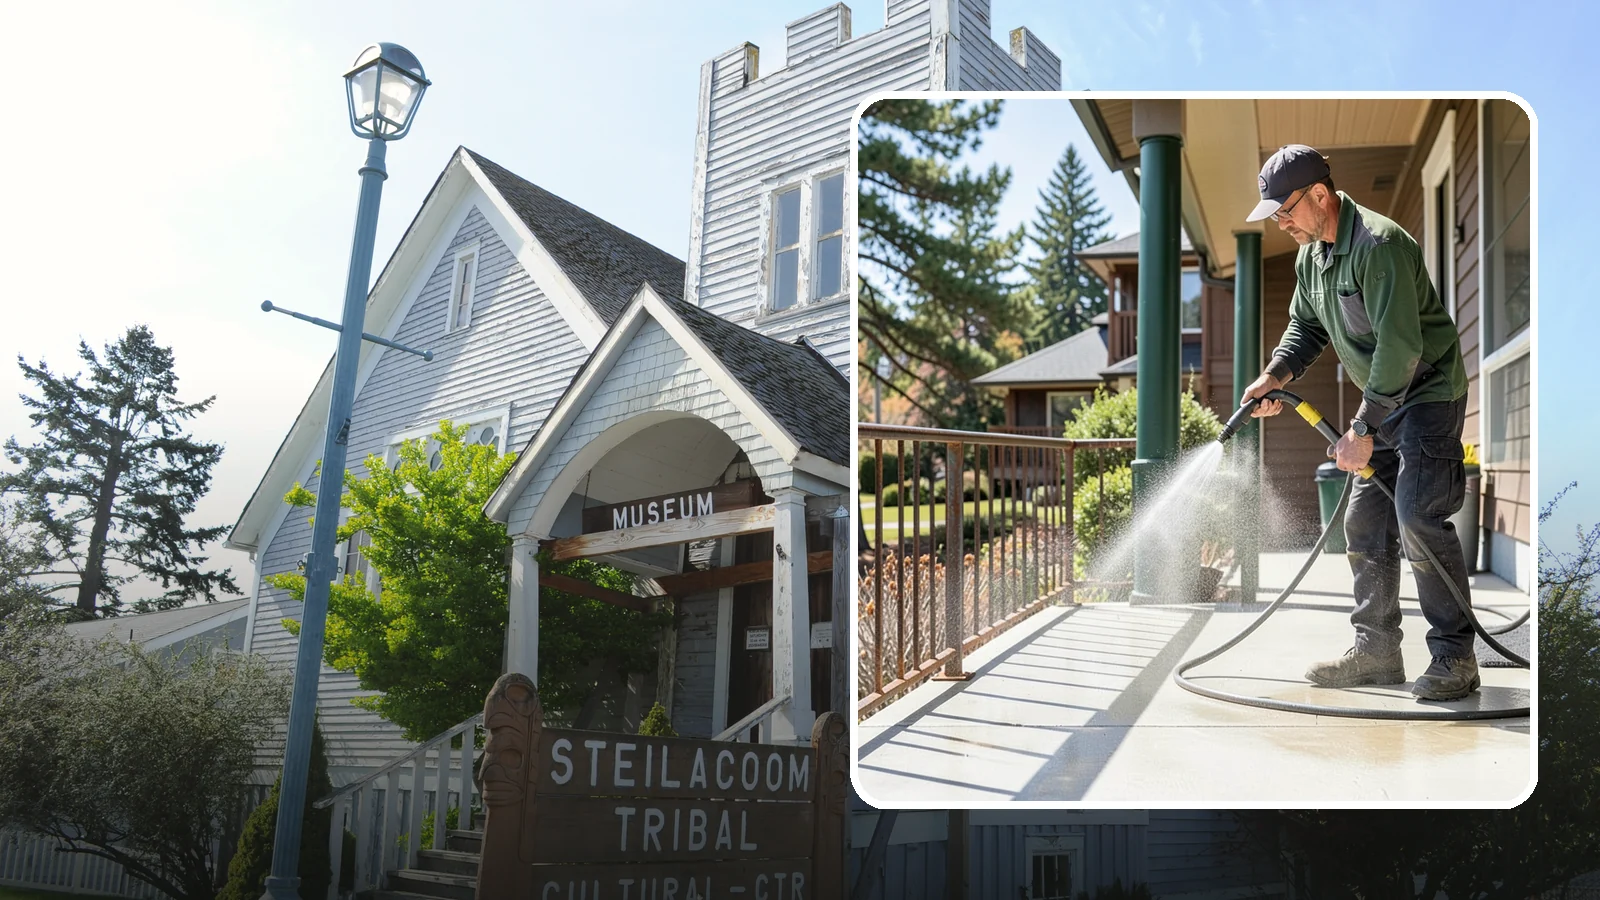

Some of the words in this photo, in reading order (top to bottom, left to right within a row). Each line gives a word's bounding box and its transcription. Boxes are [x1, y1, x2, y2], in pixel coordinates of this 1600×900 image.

[612, 491, 714, 530] MUSEUM
[550, 738, 810, 792] STEILACOOM
[614, 806, 758, 852] TRIBAL
